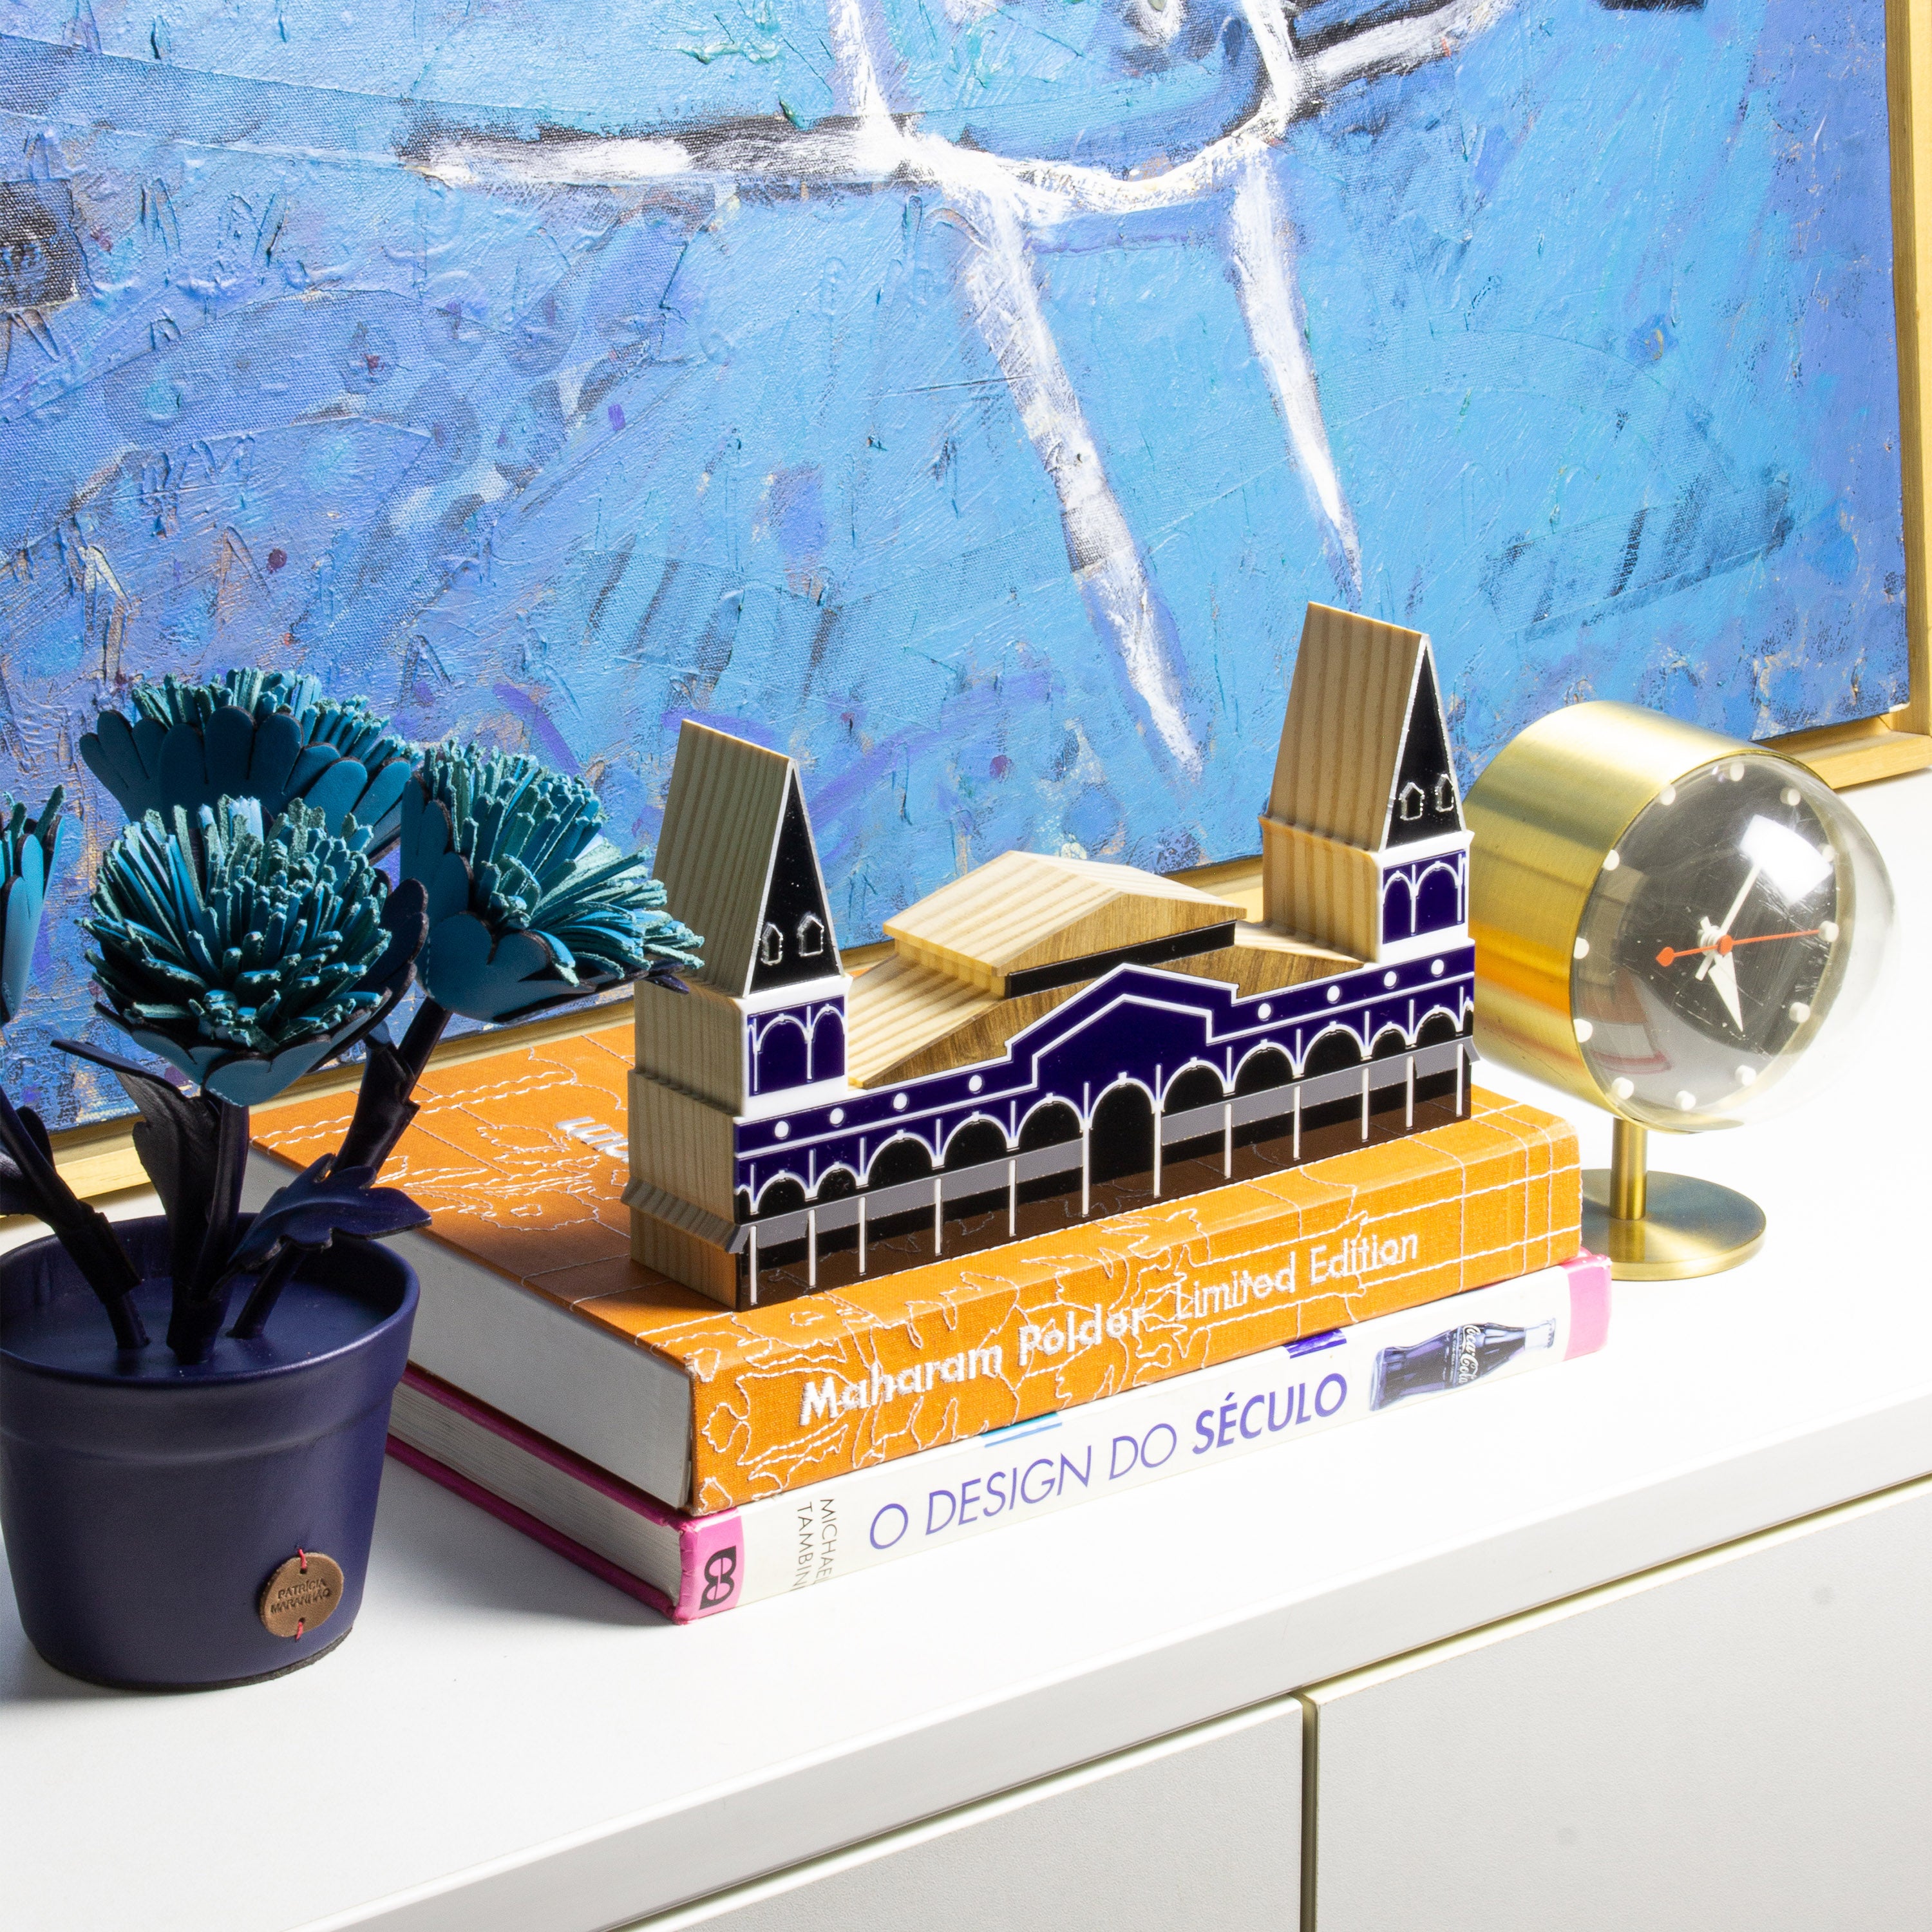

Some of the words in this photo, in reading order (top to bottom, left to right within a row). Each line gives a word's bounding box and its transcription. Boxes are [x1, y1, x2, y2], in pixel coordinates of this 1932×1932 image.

[799, 1345, 1003, 1426] Maharam
[1018, 1303, 1146, 1367] Polder
[1175, 1251, 1295, 1321] Limited
[1310, 1233, 1418, 1286] Edition
[869, 1503, 909, 1549] O
[925, 1445, 1092, 1535] DESIGN
[1109, 1423, 1177, 1480] DO
[1192, 1373, 1347, 1454] SÉCULO
